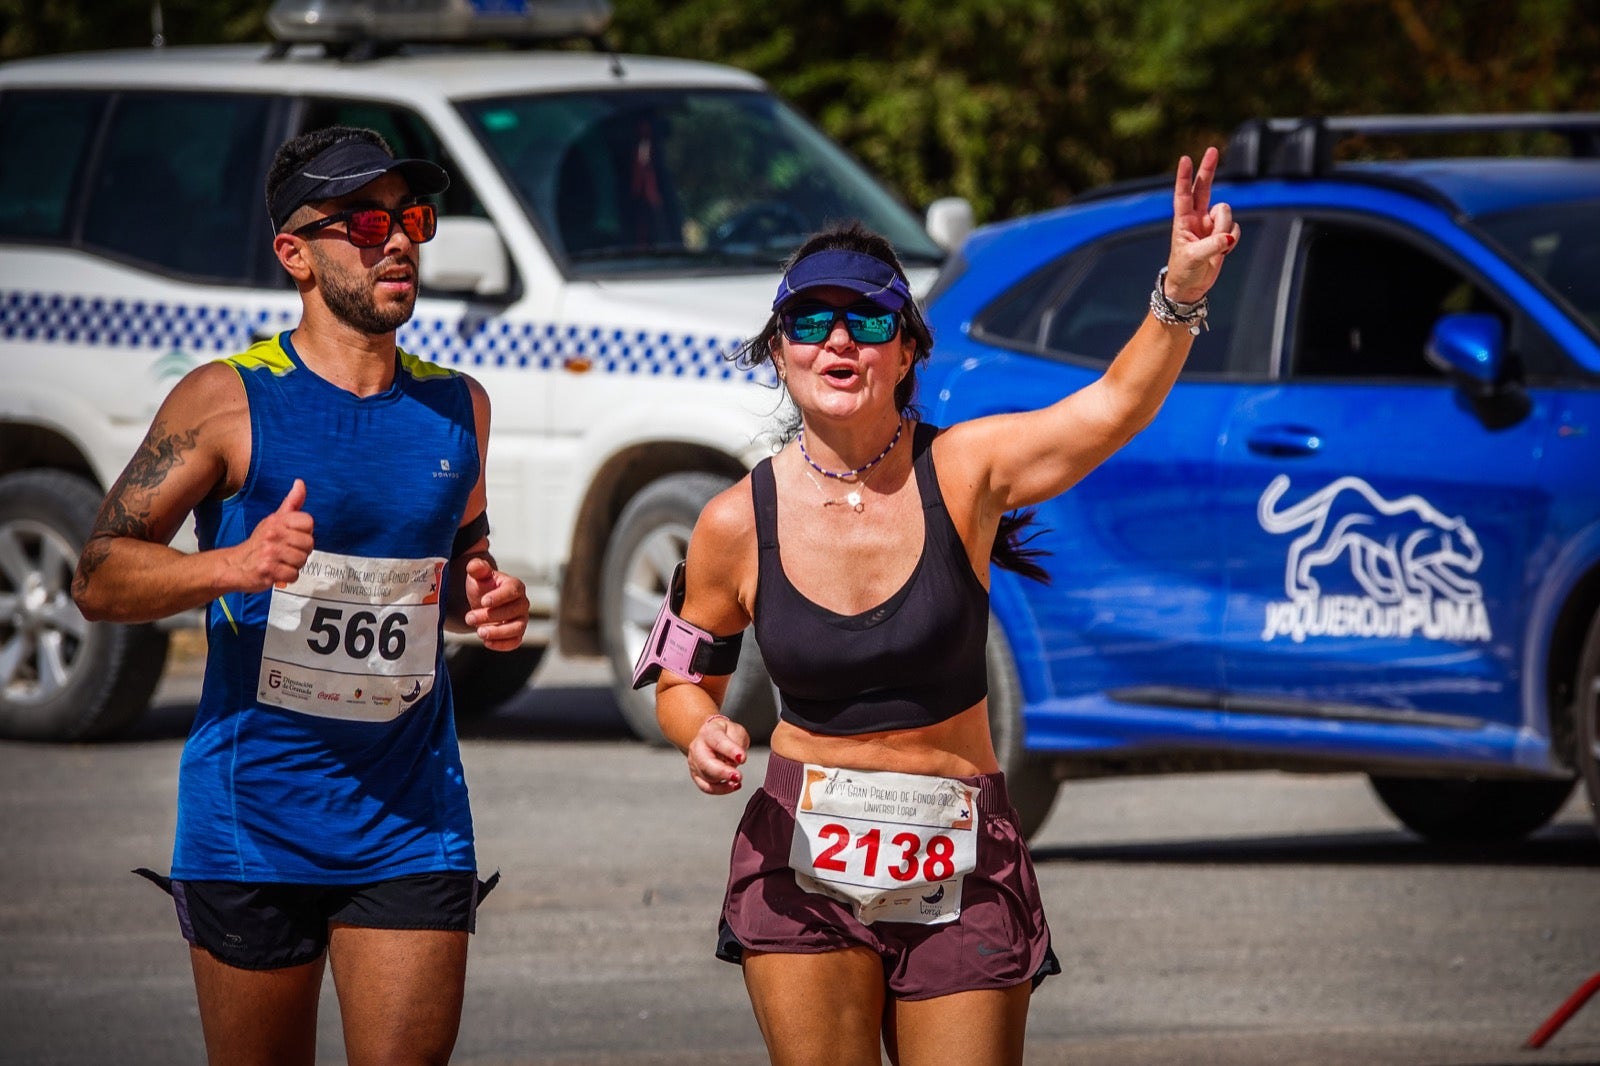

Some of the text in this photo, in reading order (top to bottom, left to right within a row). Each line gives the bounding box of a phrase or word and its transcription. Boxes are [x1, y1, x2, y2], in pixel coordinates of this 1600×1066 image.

[306, 606, 409, 661] 566
[864, 802, 917, 817] UNIVERSO LORCA
[870, 787, 898, 802] PREMIO
[900, 791, 910, 803] DE
[912, 790, 936, 805] FONDO
[813, 822, 955, 882] 2138
